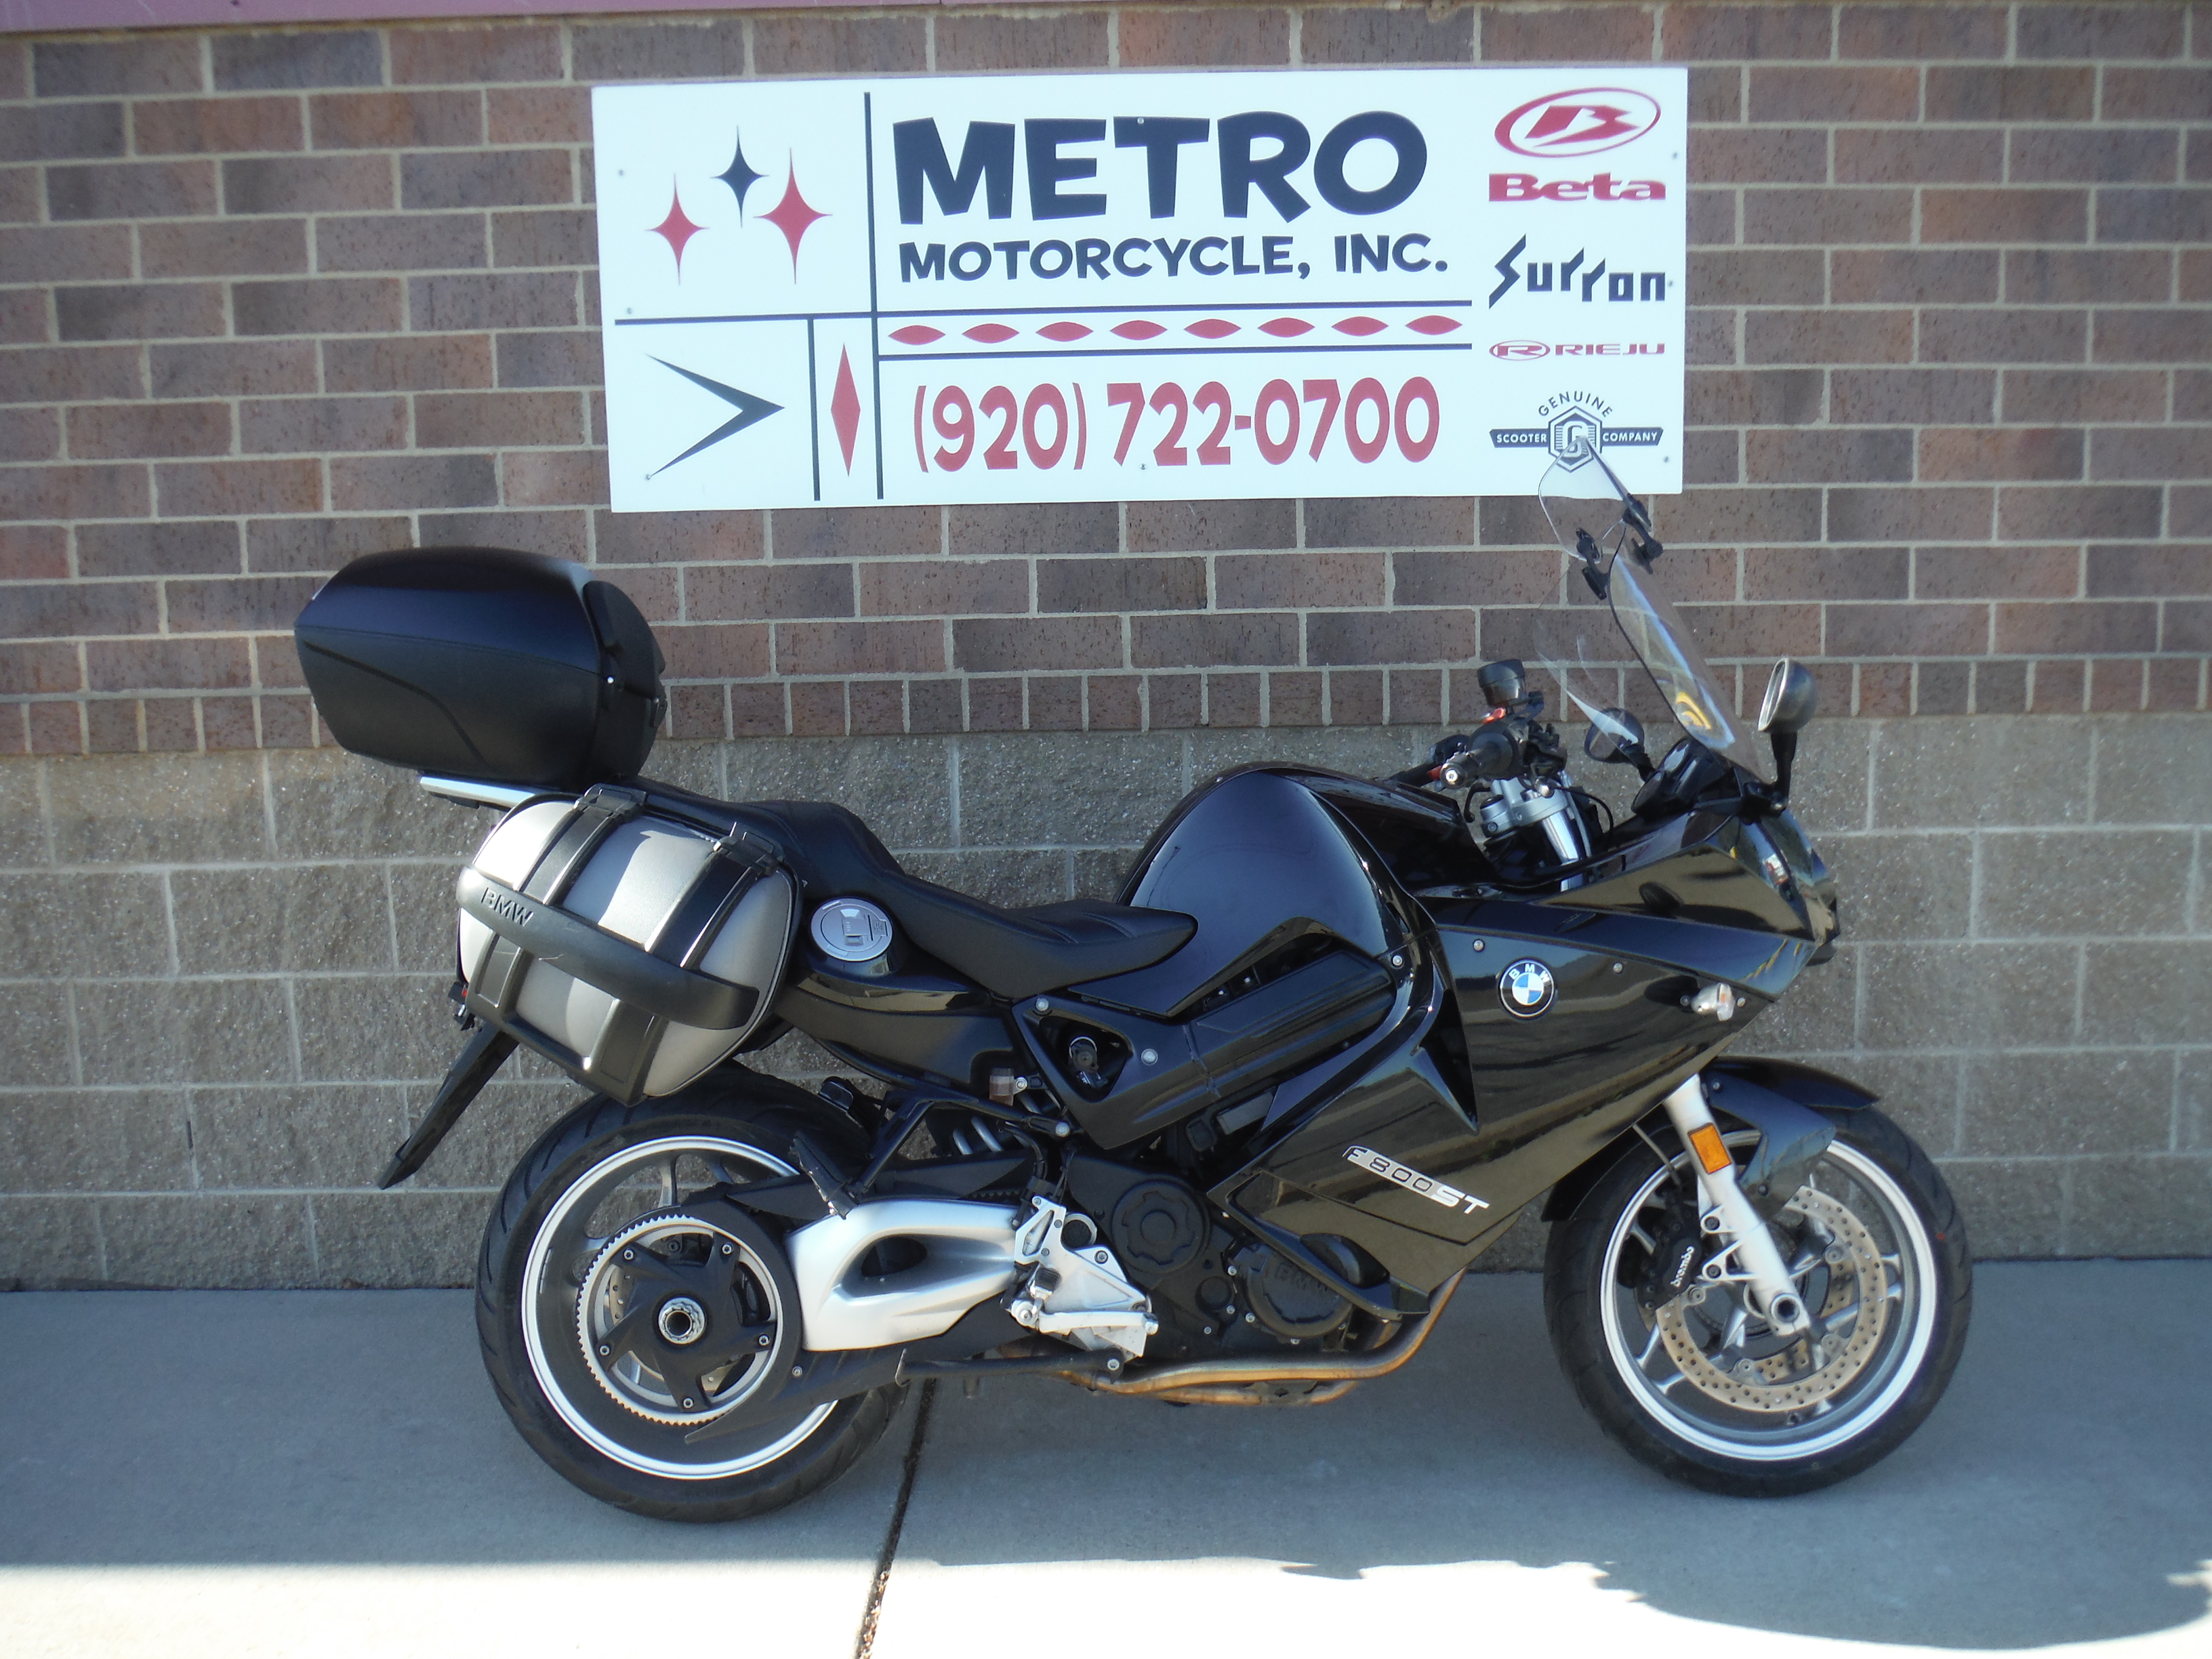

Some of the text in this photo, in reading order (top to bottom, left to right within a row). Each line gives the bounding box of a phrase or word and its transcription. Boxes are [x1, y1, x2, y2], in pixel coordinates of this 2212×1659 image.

[892, 110, 1428, 225] METRO
[1488, 171, 1666, 202] Beta
[899, 233, 1449, 283] MOTORCYCLE, INC.
[1488, 232, 1666, 310] Surron
[1555, 343, 1666, 356] RIEJU
[1538, 390, 1613, 417] GENUINE
[914, 376, 1440, 473] (920) 722-0700
[1496, 433, 1548, 443] SCOOTER
[1601, 431, 1658, 443] COMPANY
[480, 887, 535, 927] BMW
[1509, 963, 1551, 983] BMW
[1670, 1246, 1695, 1288] brembo
